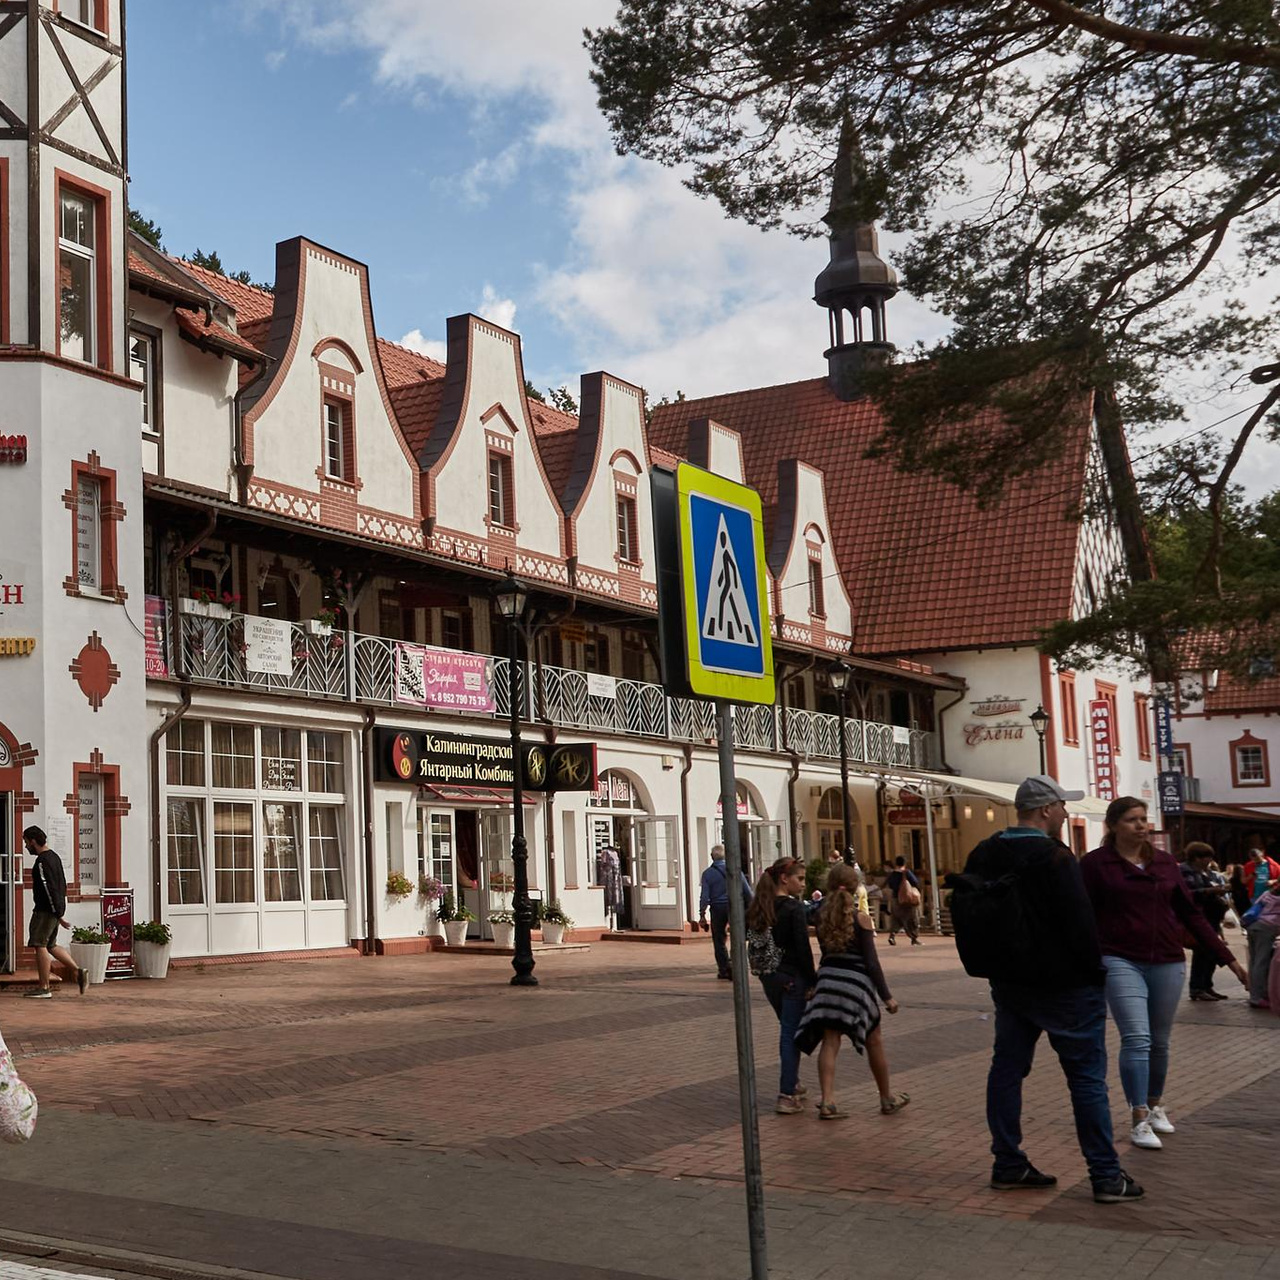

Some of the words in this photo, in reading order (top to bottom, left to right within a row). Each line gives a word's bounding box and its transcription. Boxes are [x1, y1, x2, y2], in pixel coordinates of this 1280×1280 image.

[963, 724, 1023, 746] Елена
[1092, 708, 1113, 801] МАРЦИПАН
[420, 758, 473, 782] Янтарный
